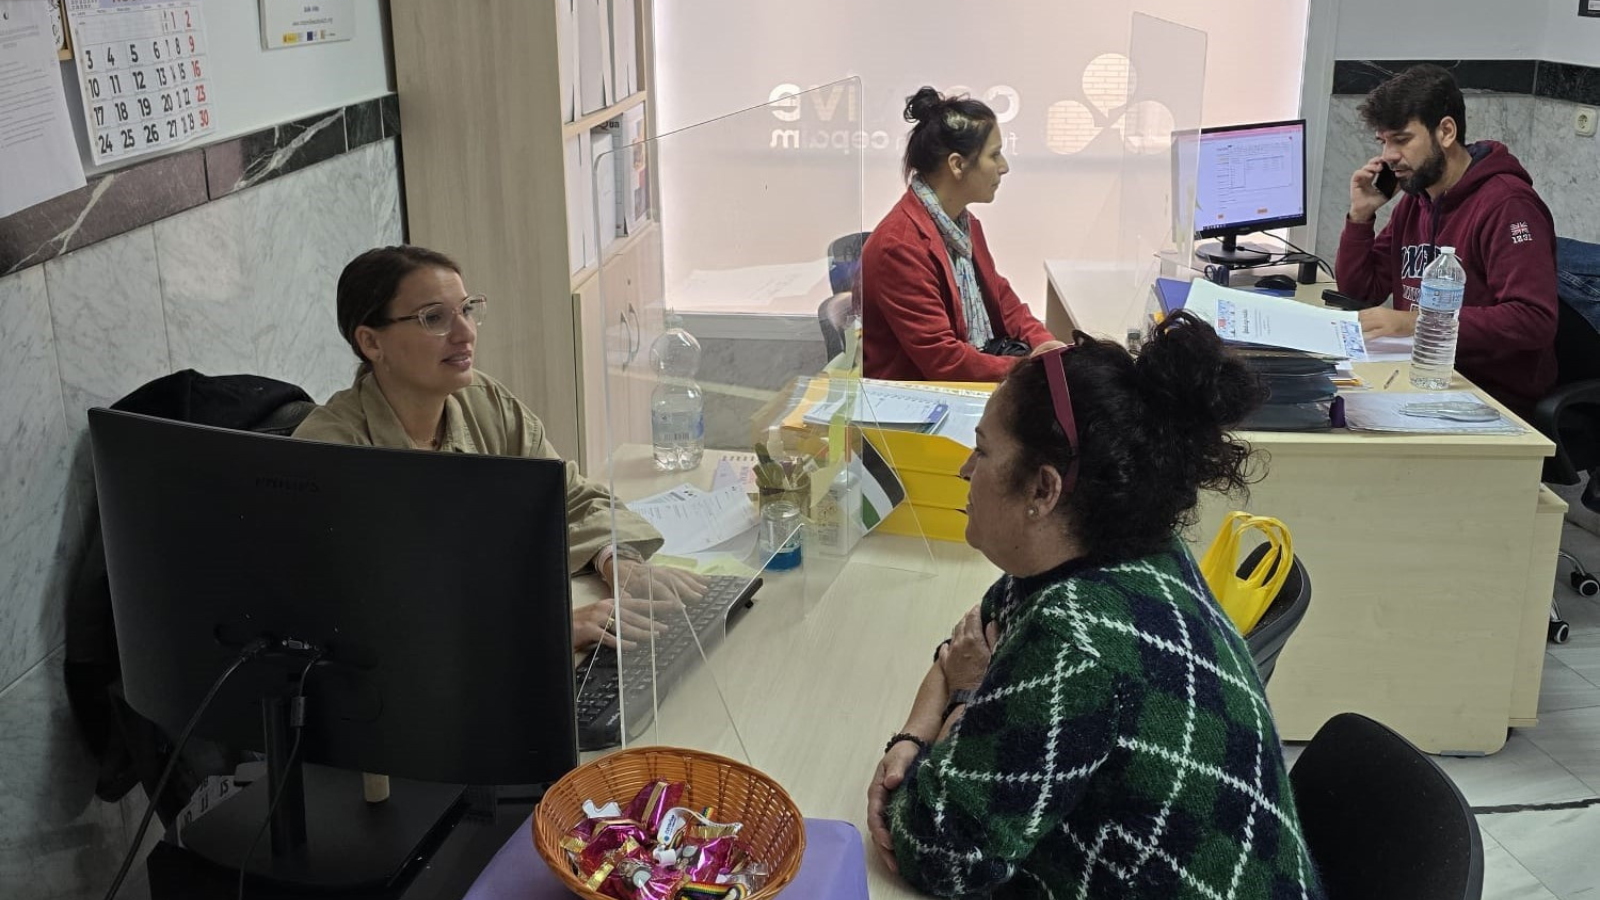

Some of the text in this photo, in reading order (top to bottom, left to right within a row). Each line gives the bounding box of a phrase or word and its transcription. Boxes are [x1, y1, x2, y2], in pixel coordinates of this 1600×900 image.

[185, 10, 191, 28] 2
[86, 50, 94, 69] 3
[107, 46, 115, 66] 4
[130, 44, 139, 63] 5
[153, 41, 160, 59] 6
[175, 37, 181, 55] 8
[188, 35, 195, 53] 9
[88, 78, 100, 98] 10
[110, 74, 122, 94] 11
[132, 71, 146, 90] 12
[156, 67, 167, 86] 13
[191, 60, 201, 77] 16
[94, 106, 104, 126] 17
[115, 102, 128, 122] 18
[138, 97, 152, 117] 19
[161, 94, 173, 112] 20
[195, 84, 206, 102] 23
[98, 133, 113, 154] 24
[121, 129, 135, 148] 25
[144, 124, 160, 143] 26
[167, 119, 178, 138] 27
[199, 109, 209, 127] 30
